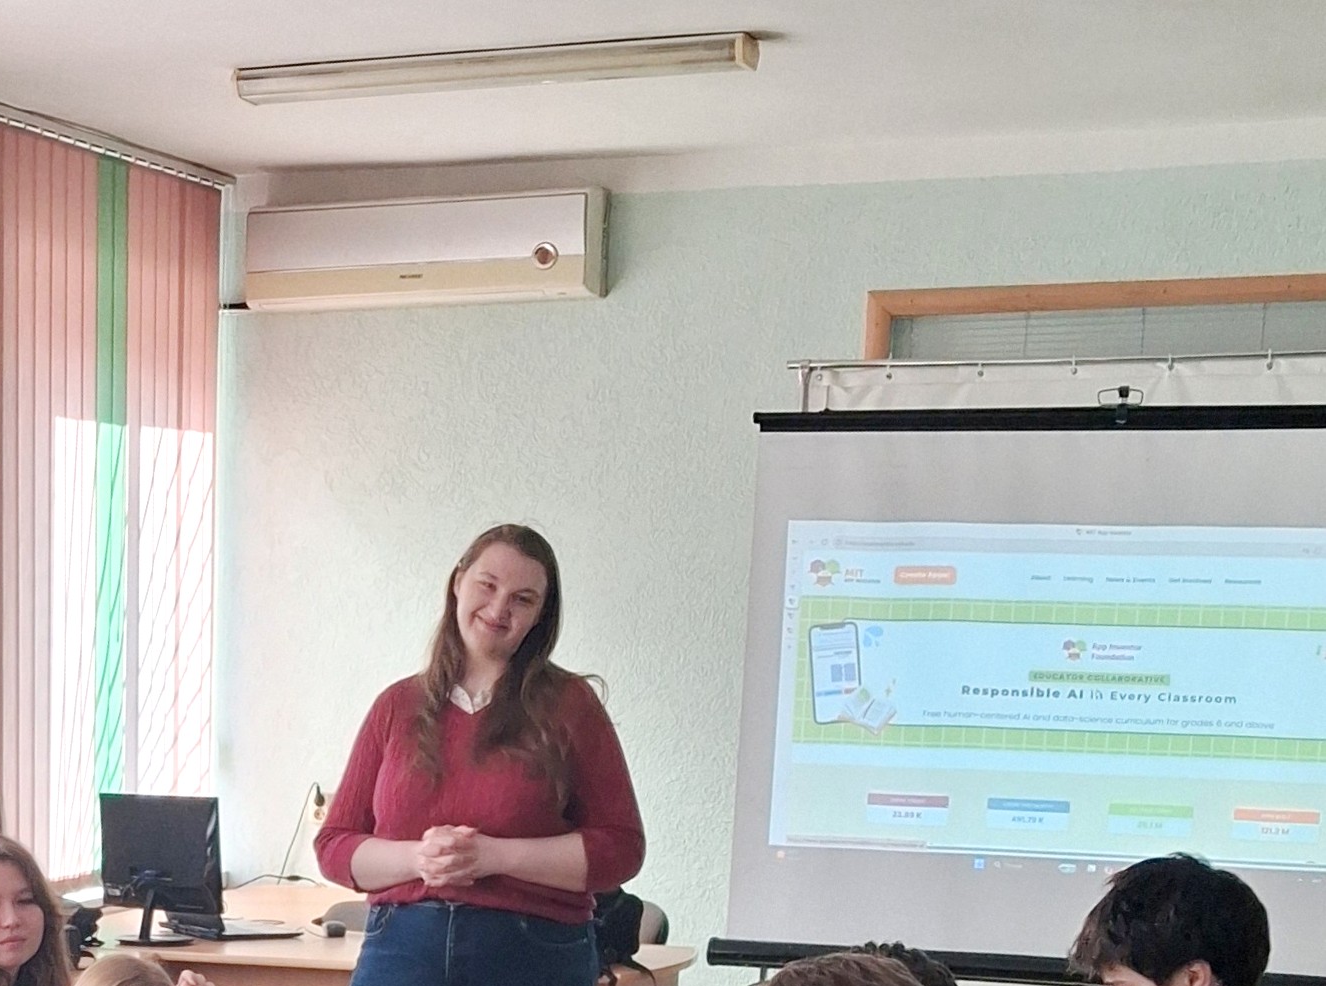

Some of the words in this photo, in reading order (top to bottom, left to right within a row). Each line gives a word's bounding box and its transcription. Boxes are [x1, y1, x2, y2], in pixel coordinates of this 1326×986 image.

[1033, 672, 1085, 681] EDUCATOR
[1086, 673, 1166, 683] COLLABORATIVE
[961, 685, 1061, 698] Responsible
[1067, 689, 1084, 699] AI
[1110, 691, 1152, 704] Every
[1157, 692, 1237, 705] Classroom
[922, 709, 942, 718] Free
[943, 710, 1021, 720] human-centered
[1032, 712, 1051, 721] and
[1052, 713, 1114, 724] data-science
[1115, 716, 1165, 725] curriculum
[1166, 717, 1180, 726] for
[1181, 718, 1215, 729] grades
[1224, 719, 1244, 729] and
[1245, 720, 1275, 730] above
